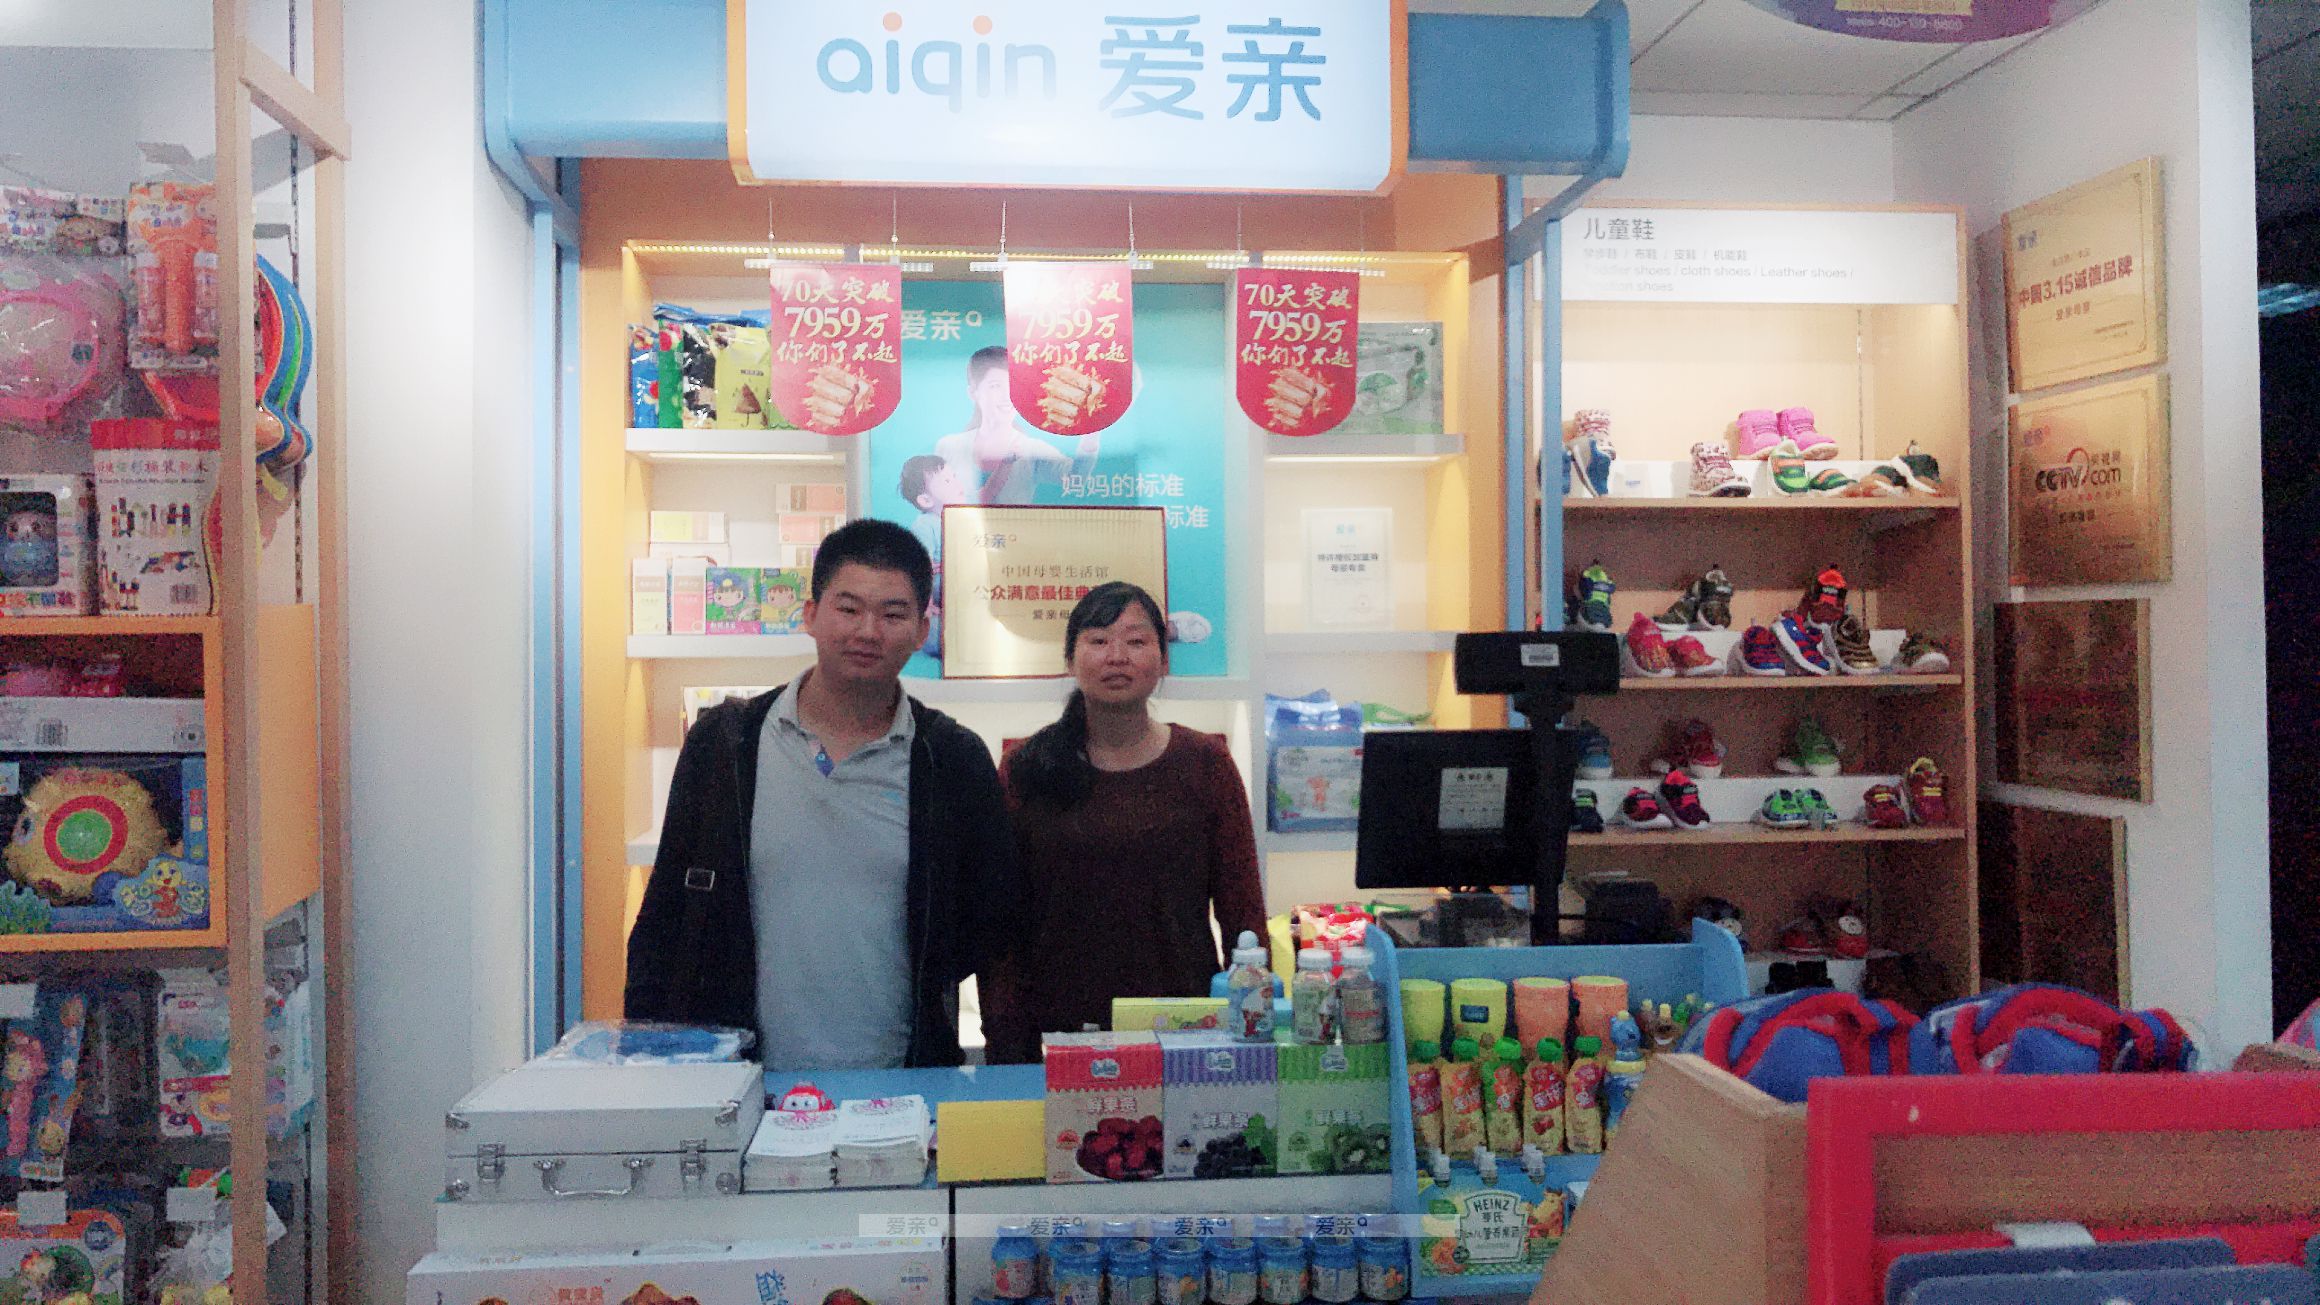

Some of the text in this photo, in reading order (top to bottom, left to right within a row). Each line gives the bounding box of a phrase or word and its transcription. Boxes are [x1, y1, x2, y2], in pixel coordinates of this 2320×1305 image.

[816, 12, 1057, 113] aiqin
[1099, 14, 1327, 122] 爱亲
[1583, 217, 1655, 241] 儿童鞋
[1633, 264, 1671, 276] shoes
[1680, 264, 1711, 276] cloth
[1713, 265, 1751, 277] shoes
[1760, 266, 1809, 278] Leather
[1810, 266, 1847, 278] shoes
[1244, 282, 1353, 311] 70天突破
[784, 307, 889, 339] 7959万
[1018, 308, 1120, 339] 7959万
[1249, 310, 1347, 344] 7959万
[776, 340, 898, 365] 你们了不起
[1012, 340, 1129, 365] 你们了不起
[1241, 342, 1354, 369] 你们了不起
[1061, 473, 1185, 498] 妈妈的标准
[1001, 564, 1110, 579] 中国母婴生活馆
[973, 583, 1098, 601] 公众满意最佳典
[1473, 1198, 1510, 1213] HEINZ
